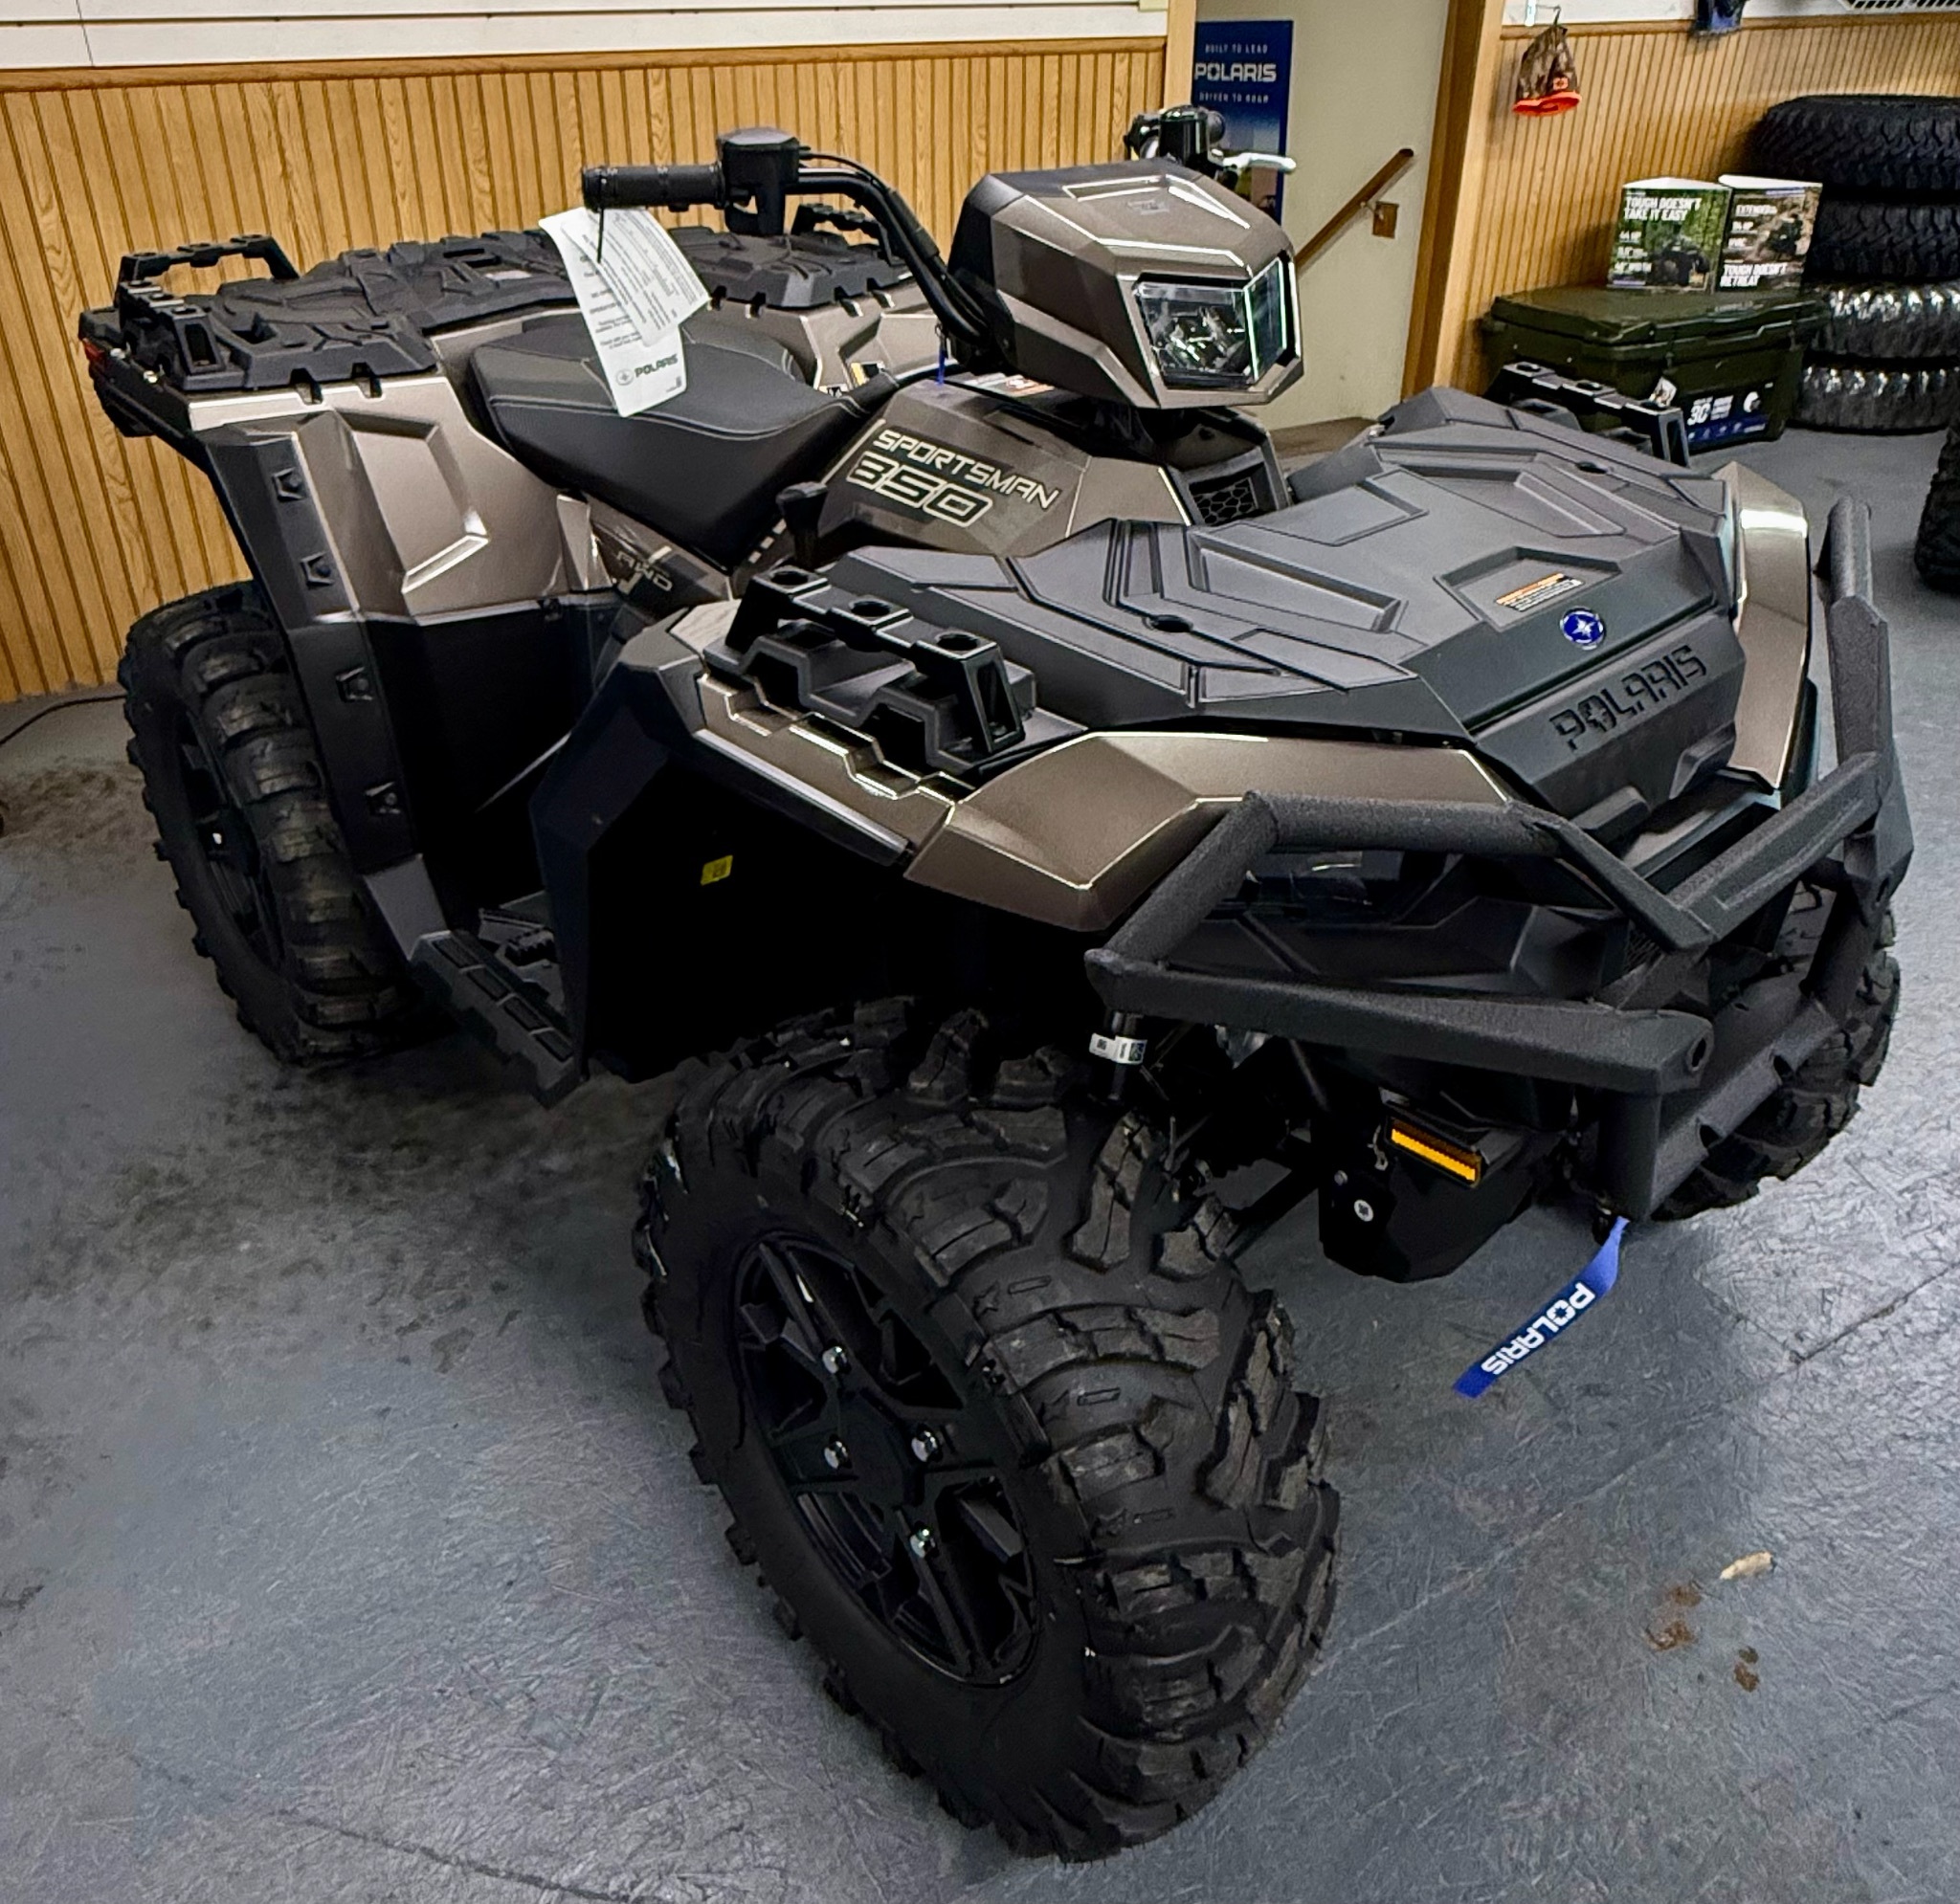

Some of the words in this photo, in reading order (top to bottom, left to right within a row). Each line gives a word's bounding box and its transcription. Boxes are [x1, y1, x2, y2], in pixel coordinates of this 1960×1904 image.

[1232, 43, 1242, 54] TO
[1245, 44, 1268, 54] LEAD
[1194, 62, 1277, 82] POLARIS
[1625, 196, 1659, 210] TOUGH
[1658, 197, 1702, 210] DOESN'T
[1624, 208, 1648, 221] TAKE
[1649, 209, 1661, 221] IT
[1660, 209, 1688, 221] EASY
[1724, 263, 1754, 276] TOUGH
[635, 353, 679, 378] POLARIS
[873, 430, 1059, 509] SPORTSMAN
[1548, 645, 1707, 750] POLARIS
[1481, 1282, 1596, 1376] POLARIS
